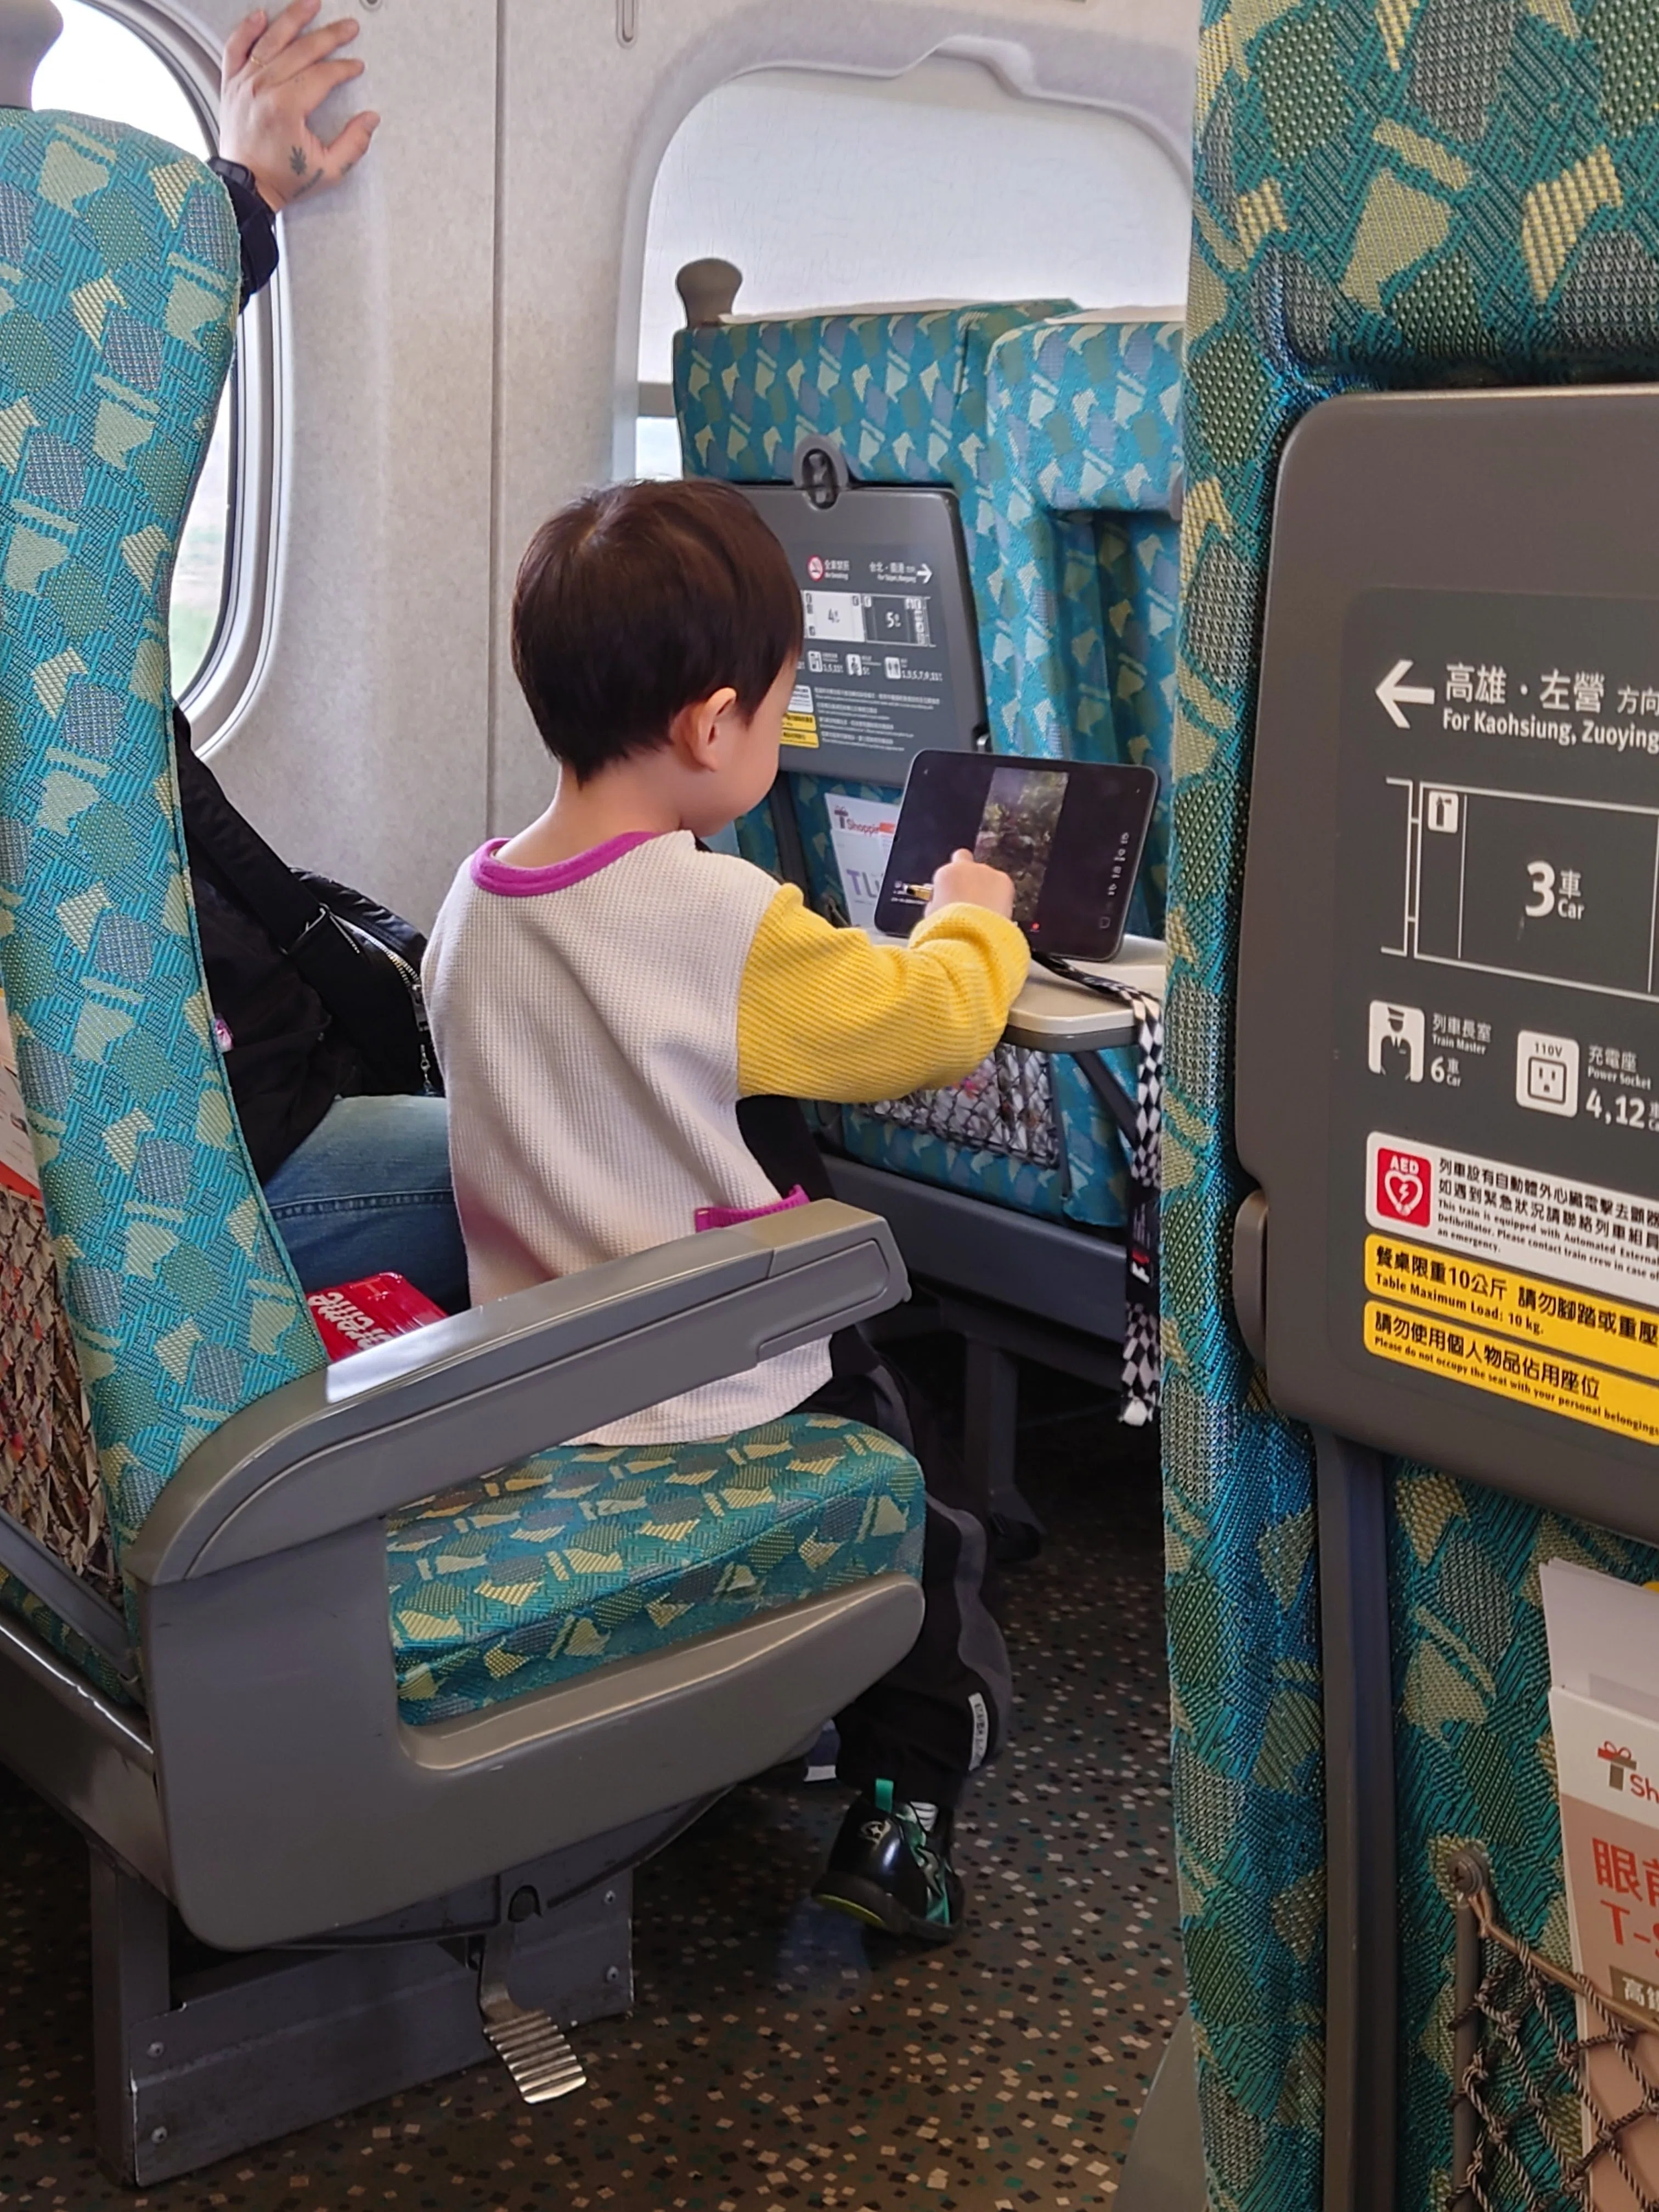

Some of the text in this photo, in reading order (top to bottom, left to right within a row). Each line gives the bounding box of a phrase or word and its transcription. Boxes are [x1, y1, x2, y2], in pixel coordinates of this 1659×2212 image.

[1617, 685, 1659, 716] 方向
[1443, 707, 1659, 754] For Kaohsiung, Zuoying
[1525, 860, 1555, 917] 3
[1559, 868, 1581, 899] 車
[1558, 898, 1584, 920] Car
[1433, 1012, 1491, 1043] 列車長室
[1432, 1033, 1486, 1055] Train Master
[1535, 1042, 1562, 1058] 110V
[1589, 1045, 1637, 1073] 充電座
[1431, 1056, 1444, 1083] 6
[1446, 1074, 1462, 1087] Car
[1588, 1065, 1651, 1090] Power Socket
[1586, 1088, 1645, 1129] 4,12
[1390, 1155, 1419, 1175] AED
[1438, 1199, 1659, 1266] This train is equipped with Automated External
[1438, 1228, 1501, 1253] an emergency.
[1438, 1213, 1494, 1237] Defibrillator.
[1497, 1229, 1525, 1244] Please
[1528, 1239, 1561, 1255] contact
[1565, 1247, 1587, 1261] train
[1589, 1255, 1612, 1268] crew
[1614, 1259, 1623, 1272] in
[1627, 1266, 1646, 1278] case
[1376, 1245, 1508, 1301] 餐桌限重10公斤
[1375, 1272, 1406, 1292] Table
[1410, 1283, 1466, 1310] Maximum
[1508, 1312, 1522, 1328] 10
[1526, 1314, 1544, 1336] kg.
[1375, 1311, 1600, 1401] 請勿使用個人物品佔用座位
[1375, 1336, 1659, 1436] Please do not occupy the seat with your personal belongings
[1630, 1773, 1659, 1804] Sh
